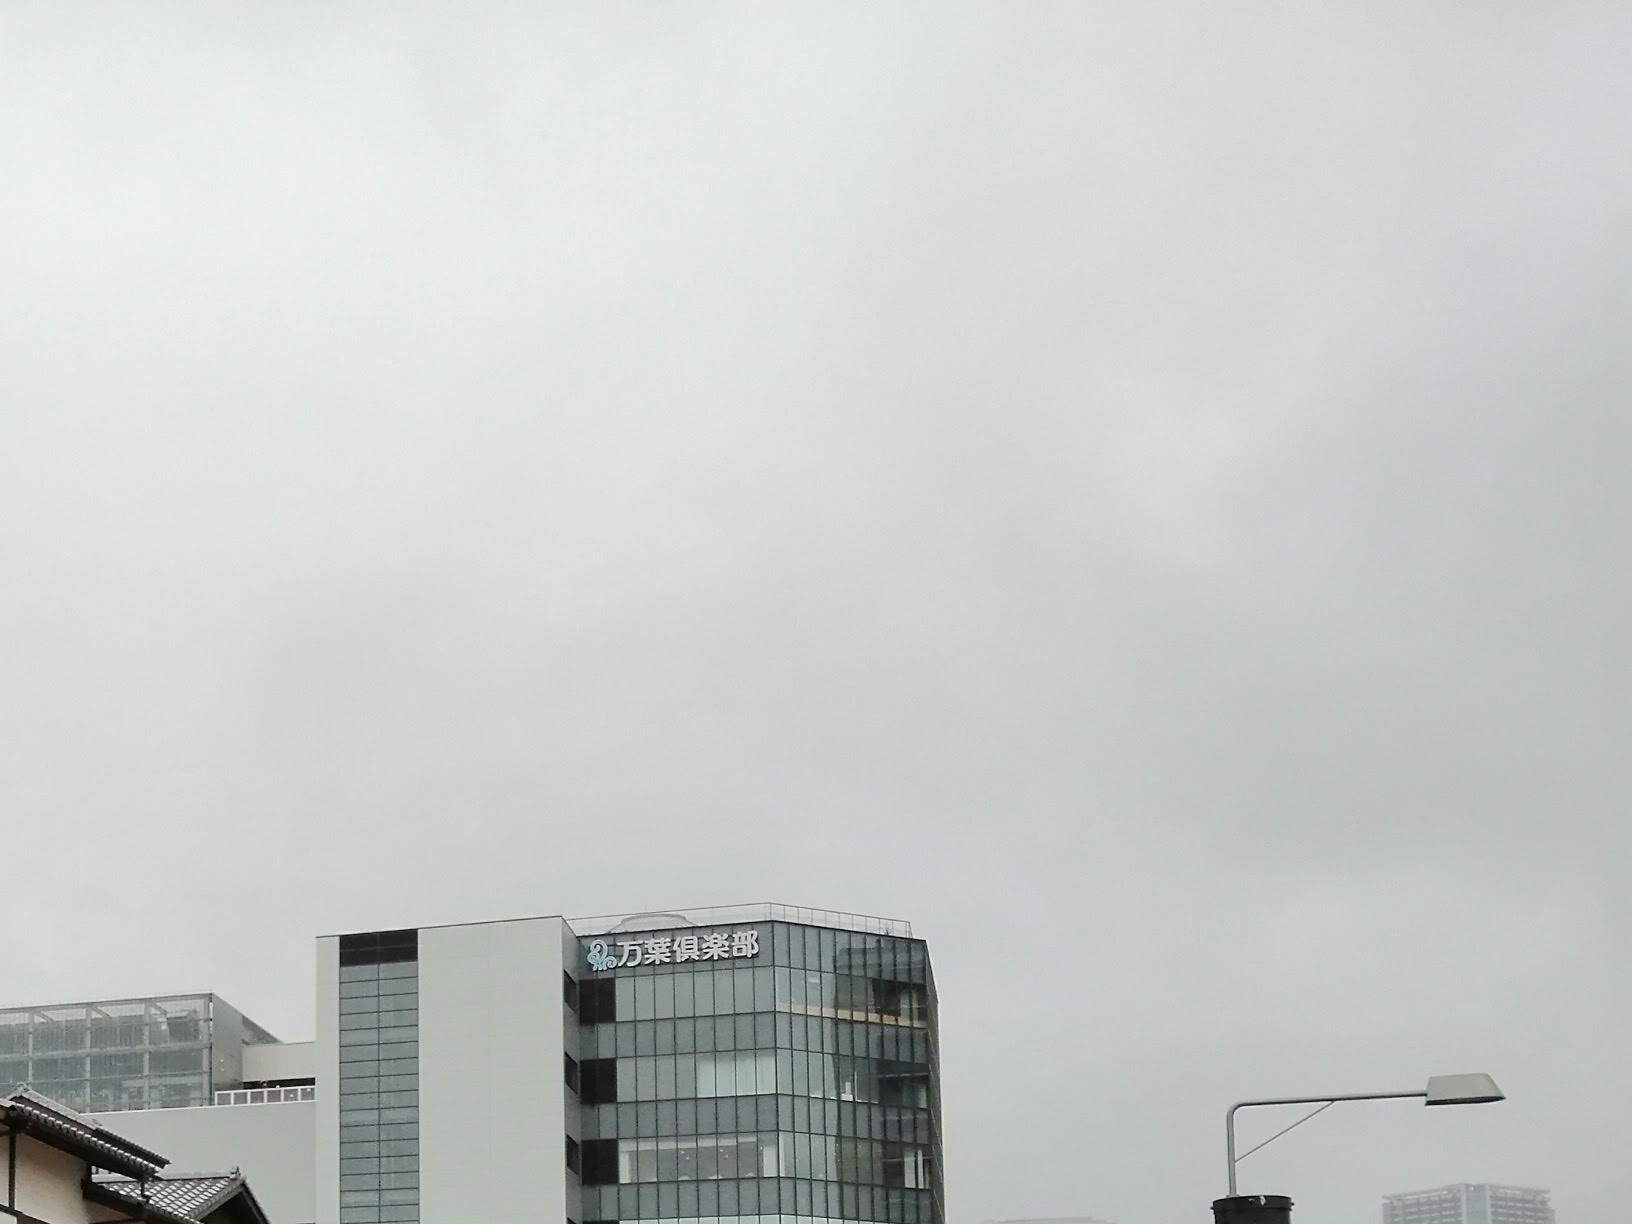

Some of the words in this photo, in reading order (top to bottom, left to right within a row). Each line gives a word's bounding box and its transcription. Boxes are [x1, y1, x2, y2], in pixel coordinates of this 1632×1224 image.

[618, 930, 759, 967] 万葉倶楽部
